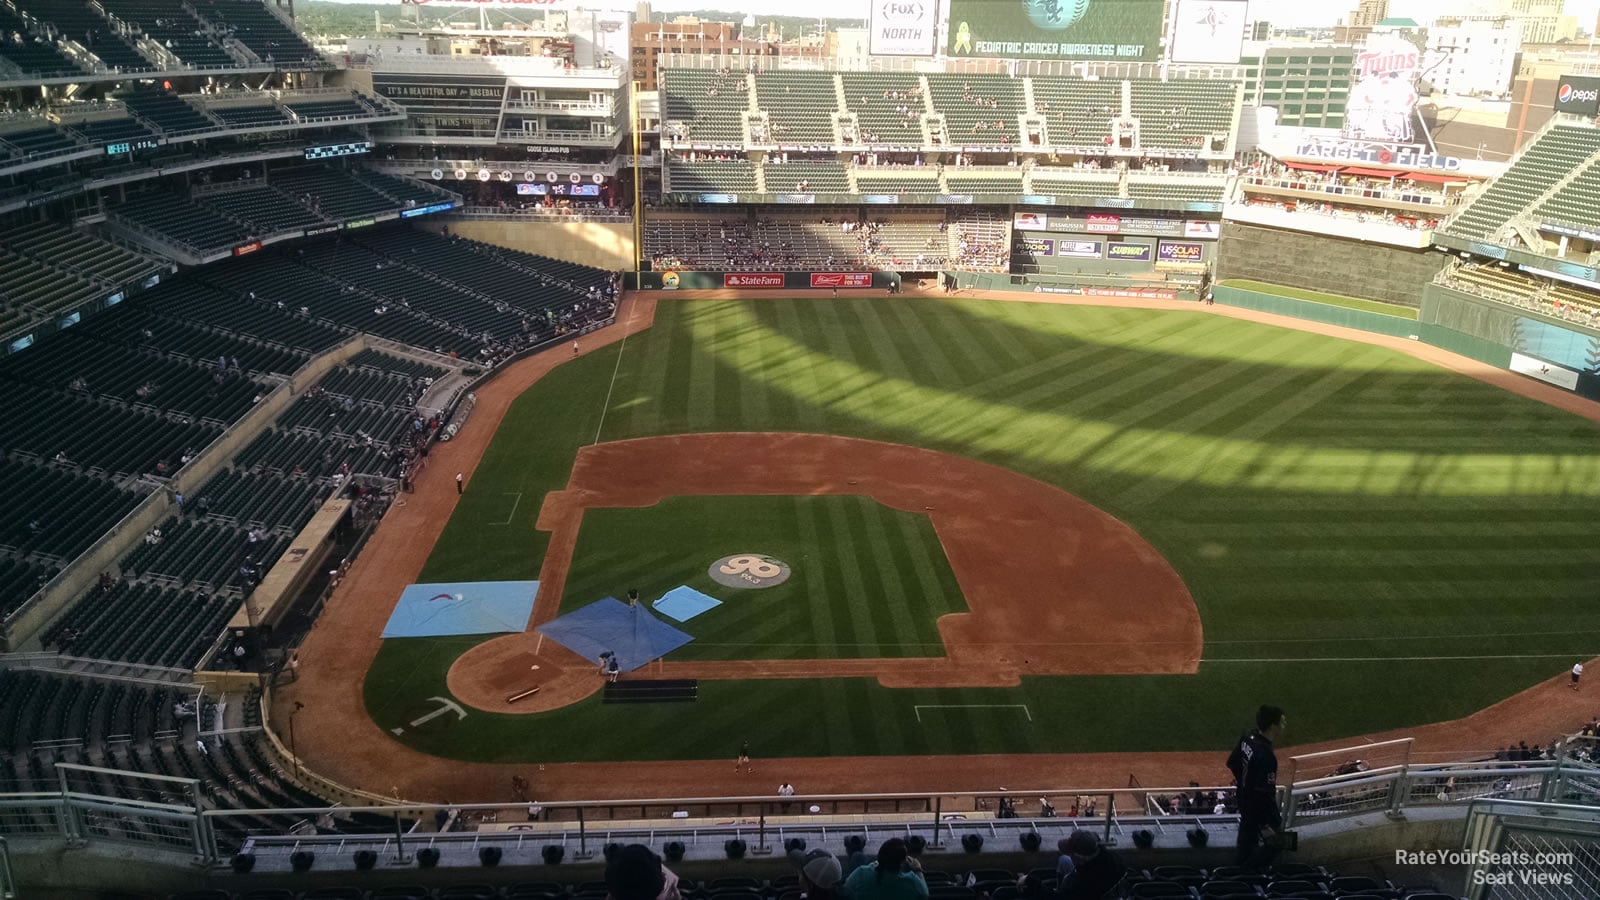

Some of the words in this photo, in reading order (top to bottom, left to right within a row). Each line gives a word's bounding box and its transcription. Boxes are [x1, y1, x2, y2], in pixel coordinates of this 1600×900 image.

[891, 3, 914, 14] FOX
[882, 27, 922, 39] NORTH
[975, 41, 1021, 53] PEDIATRIC
[1023, 42, 1058, 54] CANCER
[1060, 43, 1115, 56] AWARENESS
[1116, 44, 1144, 57] NIGHT
[1358, 51, 1416, 77] Twins
[387, 87, 402, 95] IT'S
[403, 87, 408, 95] A
[409, 87, 445, 96] BEAUTIFUL
[446, 88, 458, 96] DAY
[470, 88, 501, 97] BASEBALL
[1571, 89, 1599, 103] pepsi
[437, 118, 460, 126] TWINS
[527, 145, 542, 153] GOOSE
[1297, 144, 1377, 162] TARGET
[1396, 151, 1462, 171] FIELD
[1109, 246, 1149, 256] SUBWAY
